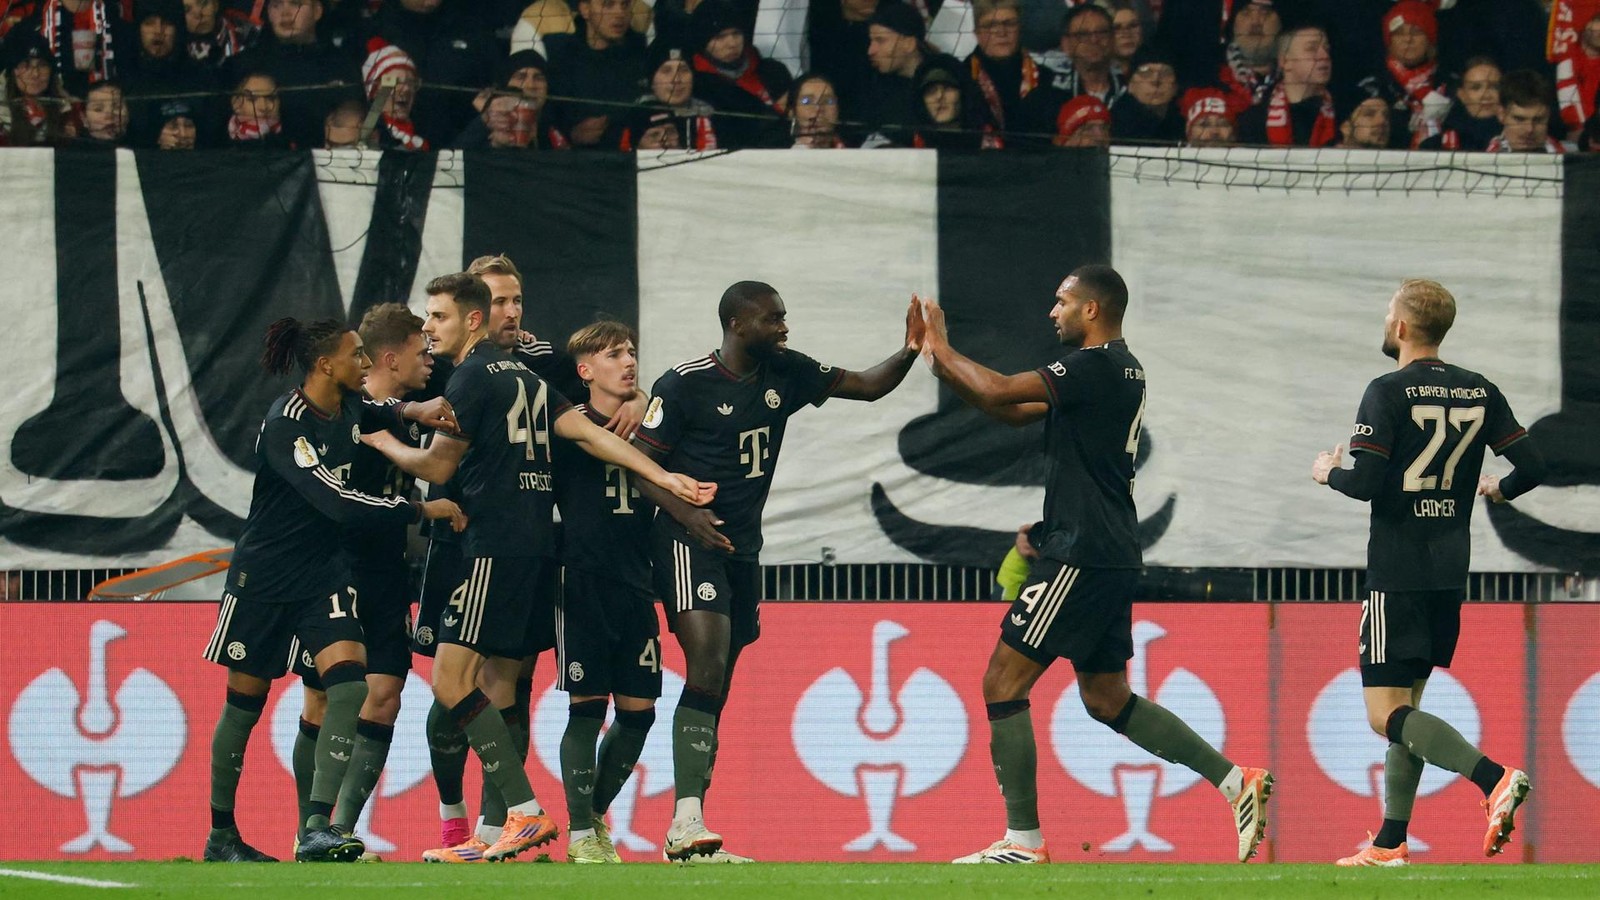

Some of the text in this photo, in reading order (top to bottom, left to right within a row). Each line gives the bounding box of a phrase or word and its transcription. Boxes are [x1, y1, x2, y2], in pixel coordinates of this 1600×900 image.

[486, 363, 500, 374] FC
[1124, 368, 1134, 379] FC
[1405, 386, 1418, 399] FC
[506, 376, 552, 463] 44
[739, 426, 770, 479] T
[1402, 405, 1486, 492] 27
[1413, 499, 1455, 517] LAIMER
[328, 585, 358, 619] 17
[1019, 580, 1048, 614] 4
